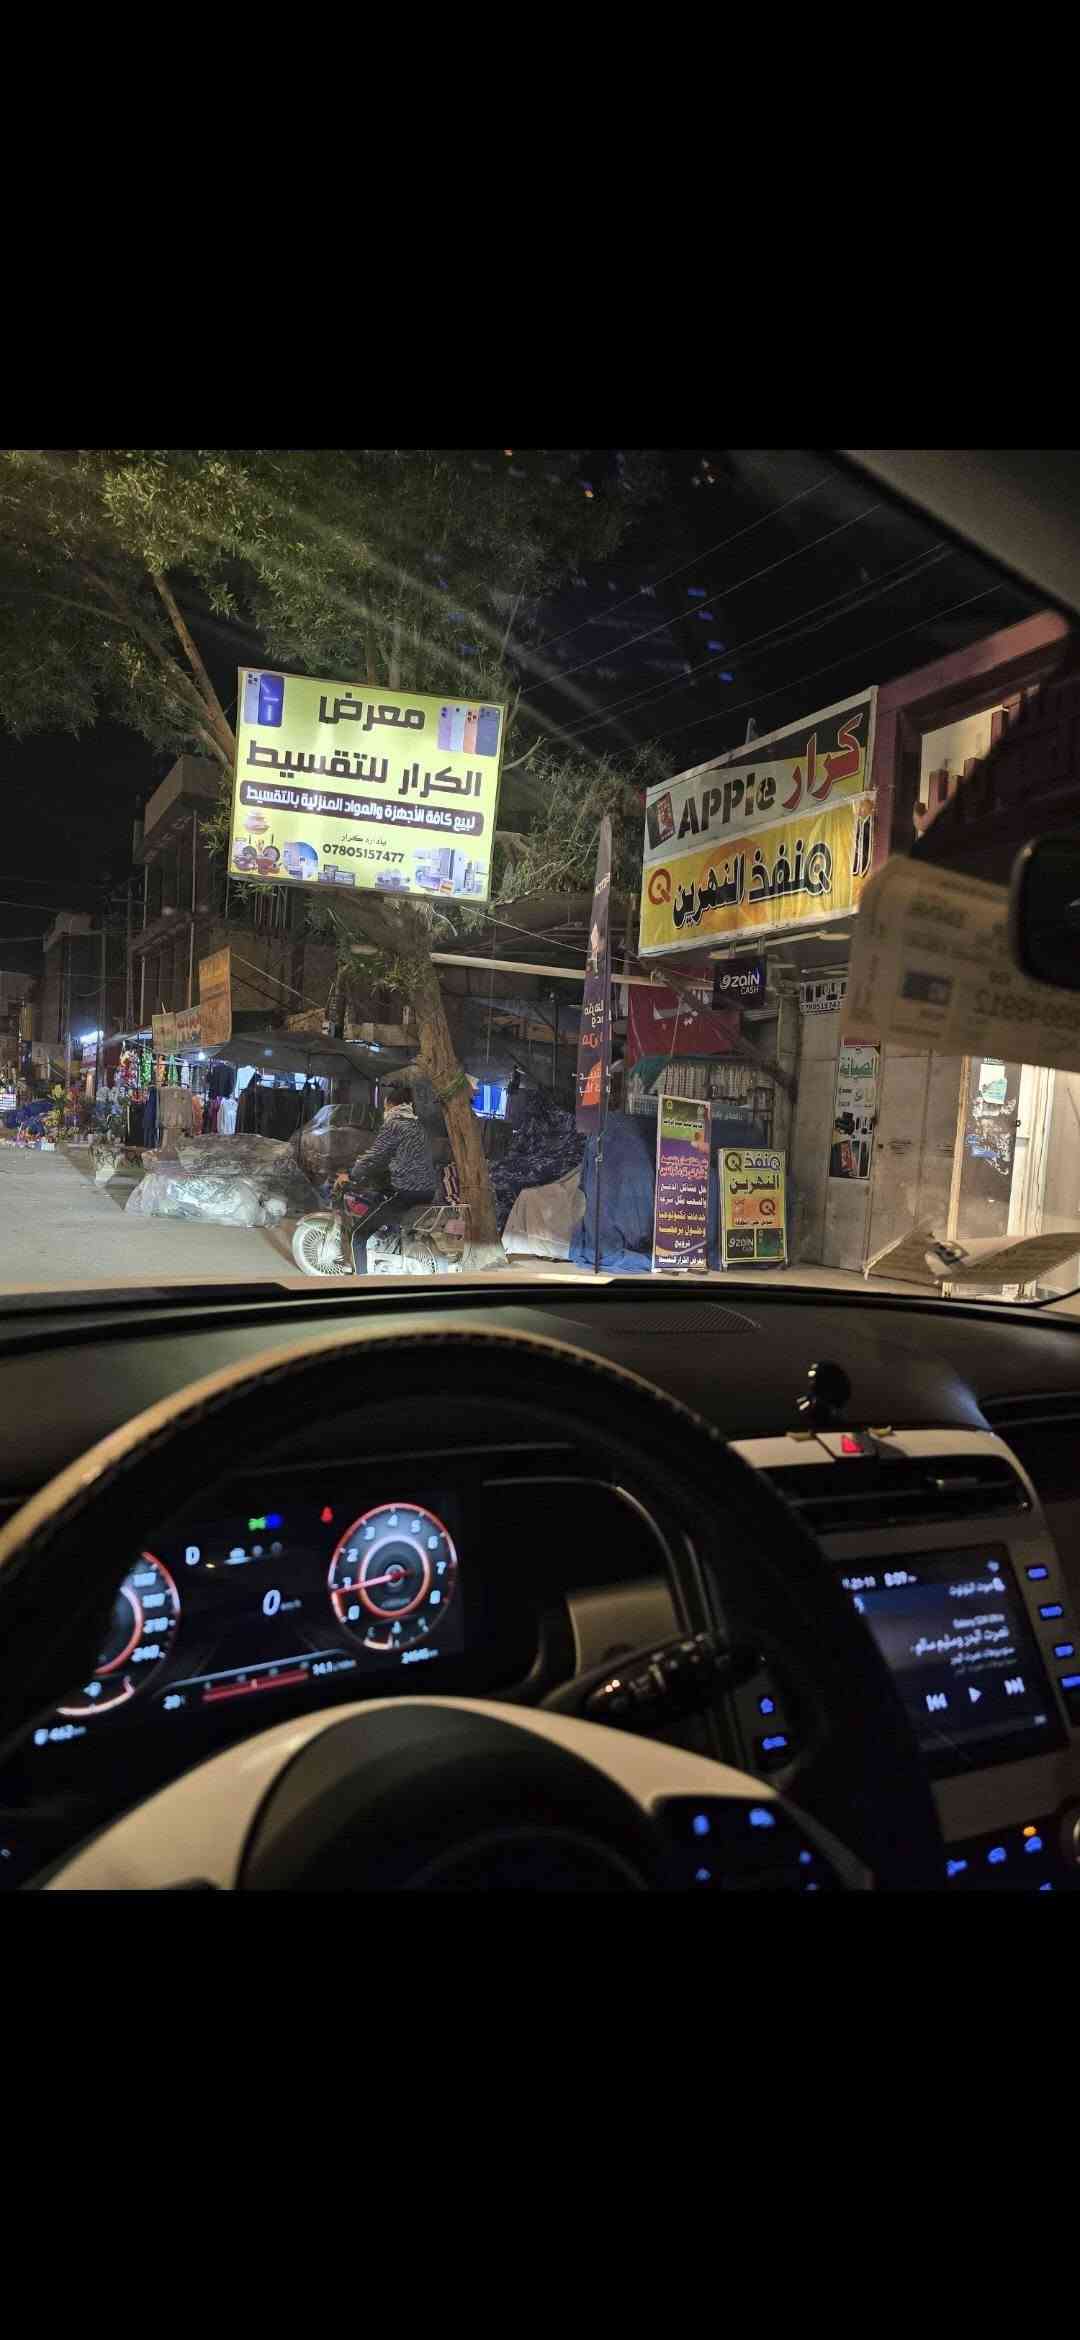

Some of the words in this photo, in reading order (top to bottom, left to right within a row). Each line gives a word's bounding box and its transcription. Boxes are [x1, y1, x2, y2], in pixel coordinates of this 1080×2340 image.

[318, 692, 426, 731] معرض
[246, 740, 389, 783] للتقسيط
[782, 712, 864, 812] كرار
[398, 763, 482, 798] الكرار
[246, 785, 299, 807] بالتقسيط
[301, 794, 343, 814] المنزلية
[343, 800, 383, 820] والمواد
[384, 803, 425, 824] الأجهزة
[426, 811, 451, 827] كافة
[452, 814, 476, 833] لبيع
[322, 843, 405, 863] 07805157477
[672, 853, 748, 929] النهرين
[388, 1515, 399, 1527] 4
[411, 1520, 421, 1533] 5
[364, 1526, 376, 1540] 3
[347, 1548, 359, 1563] 2
[263, 1589, 281, 1616] 0
